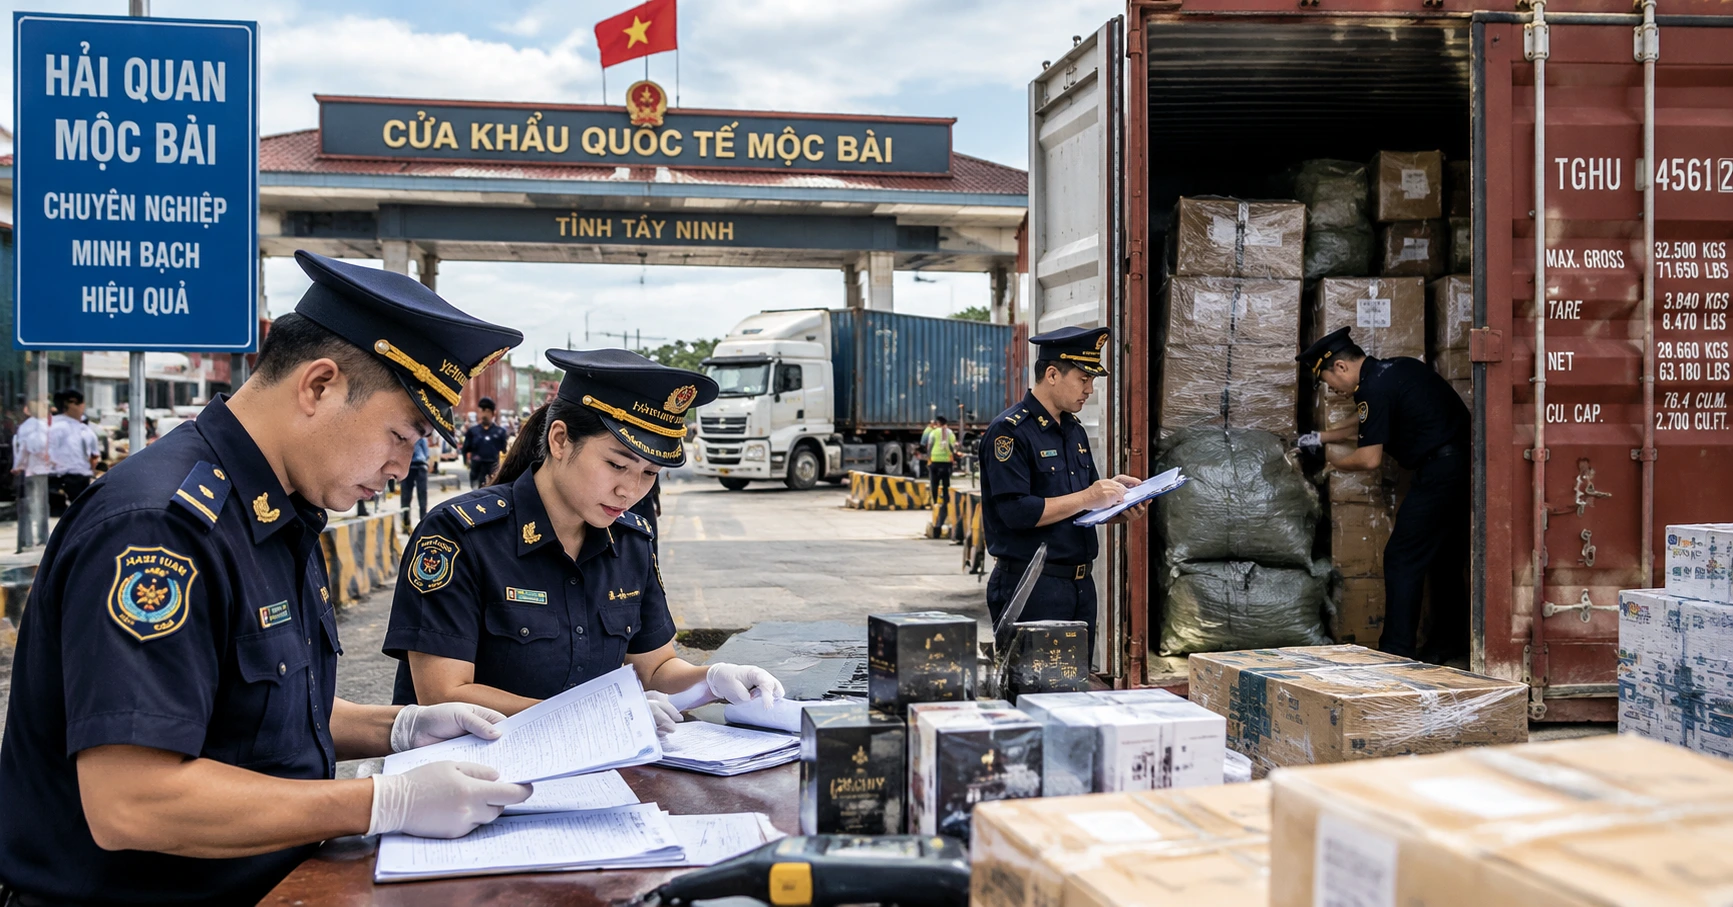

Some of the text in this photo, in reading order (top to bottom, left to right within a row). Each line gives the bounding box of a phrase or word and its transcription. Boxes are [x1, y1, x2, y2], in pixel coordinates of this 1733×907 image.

[46, 41, 226, 103] HẢI QUAN
[55, 111, 141, 171] MỘC
[383, 111, 459, 149] CỬA
[471, 112, 569, 153] KHẨU
[693, 121, 739, 158] TẾ
[748, 126, 825, 166] MỘC
[837, 129, 893, 163] BÀI
[1555, 157, 1621, 190] TGHU
[1655, 158, 1712, 191] 4561
[44, 188, 227, 229] CHUYÊN NGHIỆP
[676, 220, 734, 240] NINH
[72, 239, 200, 274] MINH BẠCH
[1546, 249, 1625, 269] MAX. GROSS
[1655, 242, 1726, 259] 32.500 KGS
[1656, 261, 1729, 279] 71.650 LBS
[82, 280, 189, 318] HIỆU QUẢ
[1663, 292, 1730, 309] 3.840 KGS
[1549, 300, 1583, 320] TARE
[1662, 312, 1726, 330] 8.470 LBS
[1657, 341, 1729, 359] 28.660 KGS
[1548, 351, 1574, 371] NET
[1659, 362, 1730, 381] 63.180 LBS
[1664, 392, 1727, 409] 76.4 CU.M.
[1546, 403, 1604, 423] CU. CAP.
[1656, 412, 1730, 430] 2.700 CU.FT.
